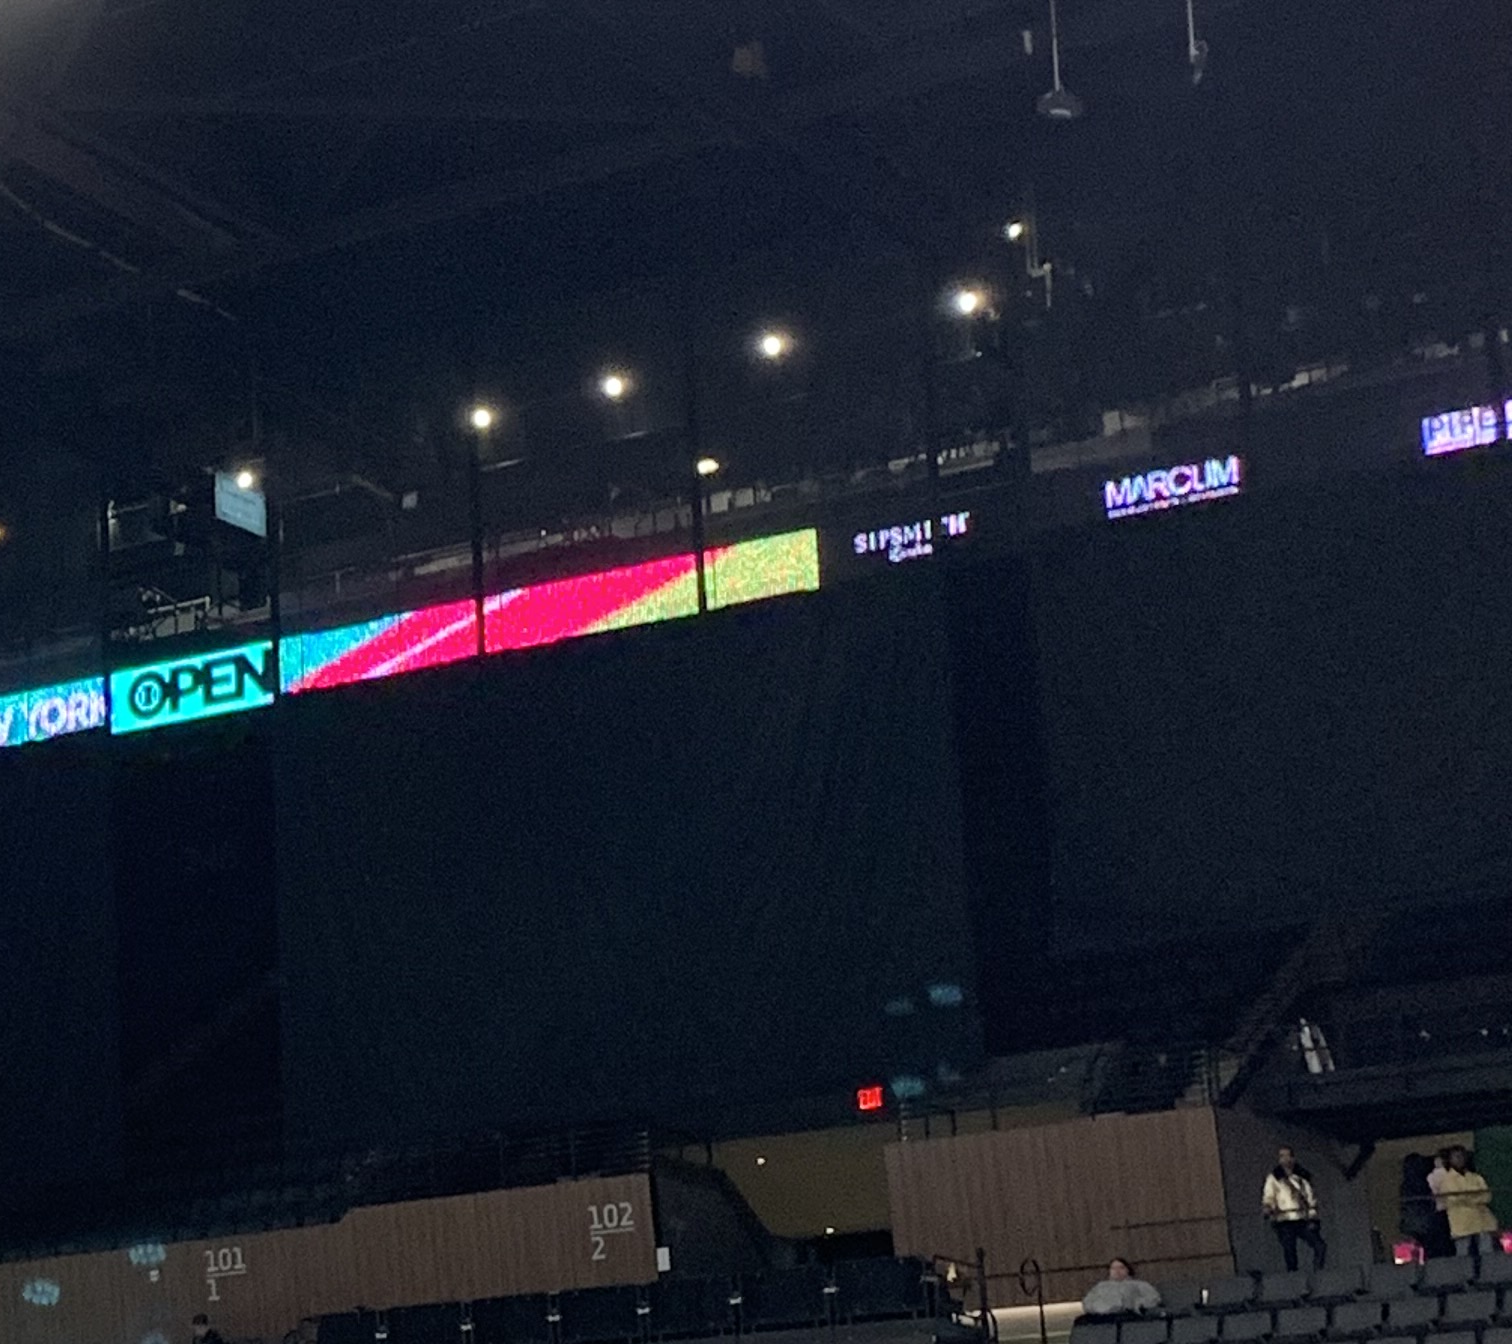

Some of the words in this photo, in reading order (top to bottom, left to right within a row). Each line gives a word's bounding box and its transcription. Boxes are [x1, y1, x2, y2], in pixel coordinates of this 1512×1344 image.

[128, 648, 276, 720] OPEN
[589, 1202, 635, 1230] 102
[205, 1247, 246, 1273] 101
[591, 1236, 608, 1262] 2
[207, 1280, 220, 1302] 1
